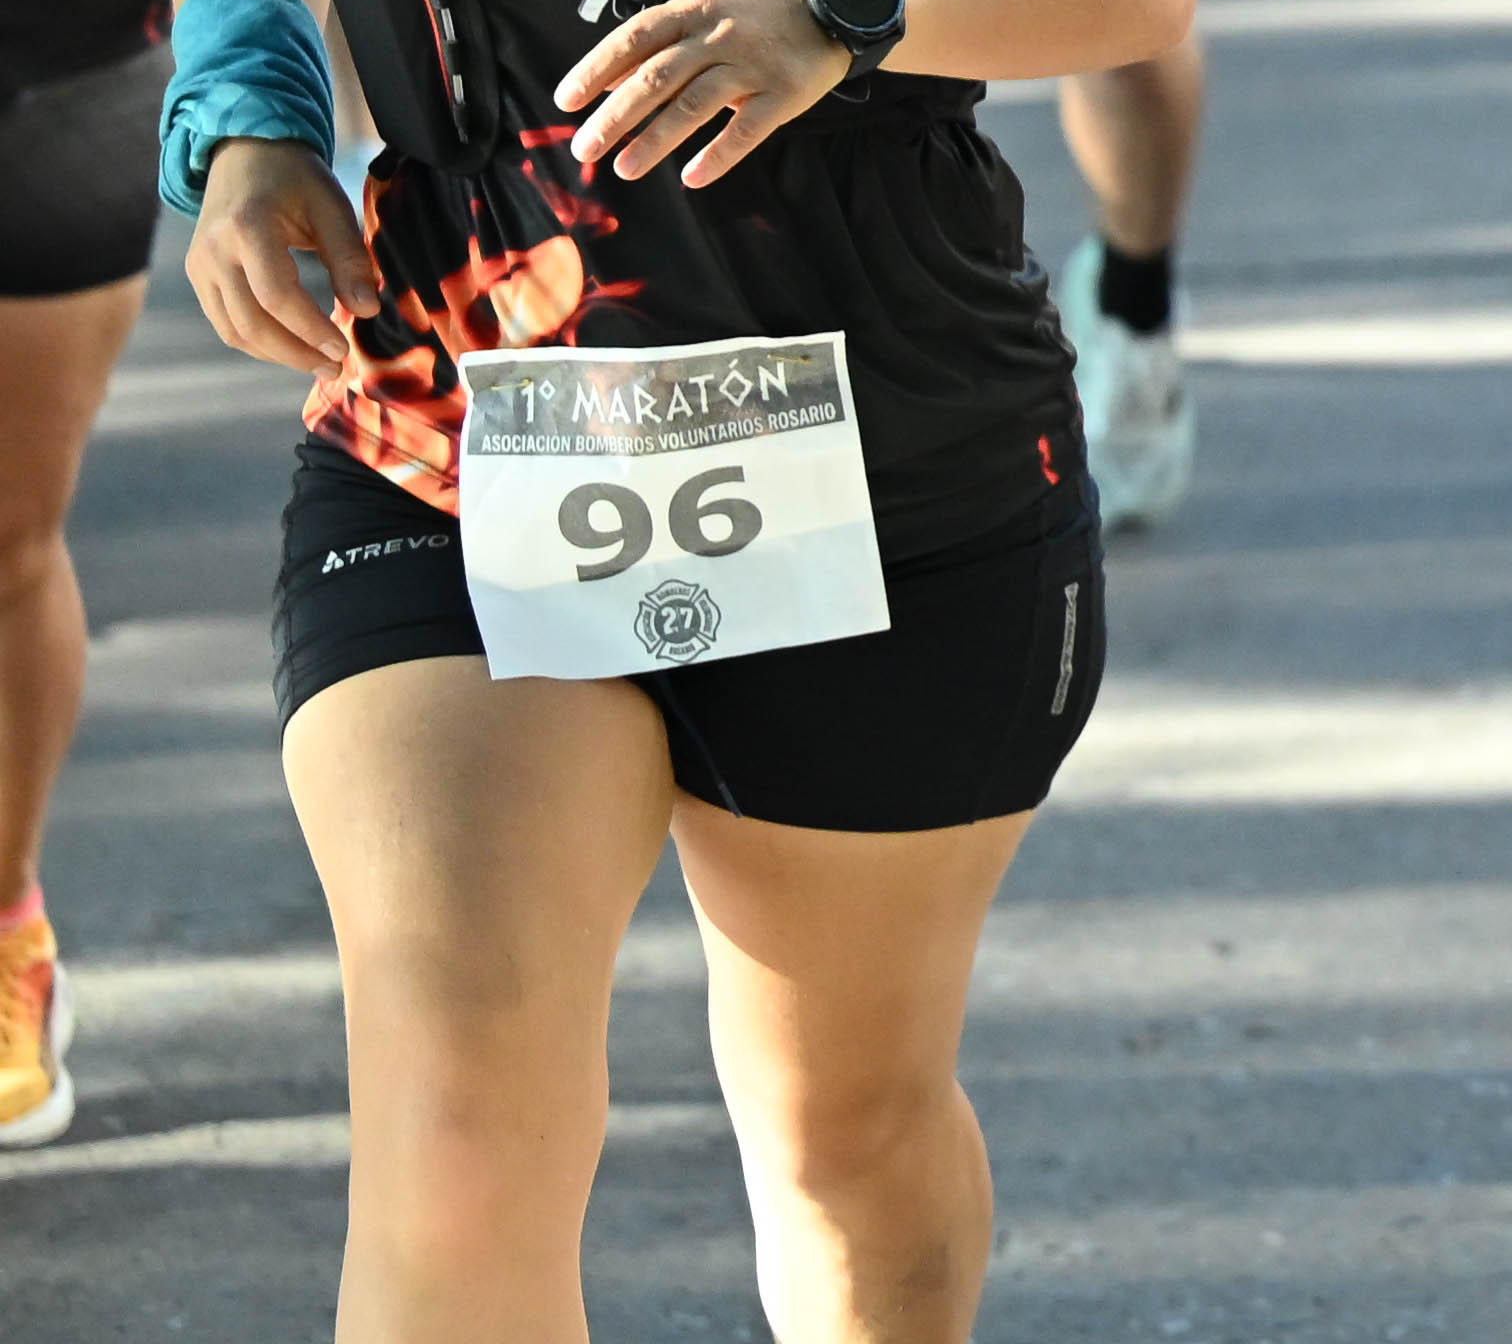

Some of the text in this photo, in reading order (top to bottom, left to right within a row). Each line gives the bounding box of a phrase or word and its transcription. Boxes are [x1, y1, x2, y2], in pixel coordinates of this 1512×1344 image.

[521, 358, 789, 424] 1° MARATÓN
[481, 401, 836, 455] ASOCIACIÓN BOMBEROS VOLUNTARIOS ROSARIO
[558, 465, 763, 582] 96
[661, 606, 693, 635] 27
